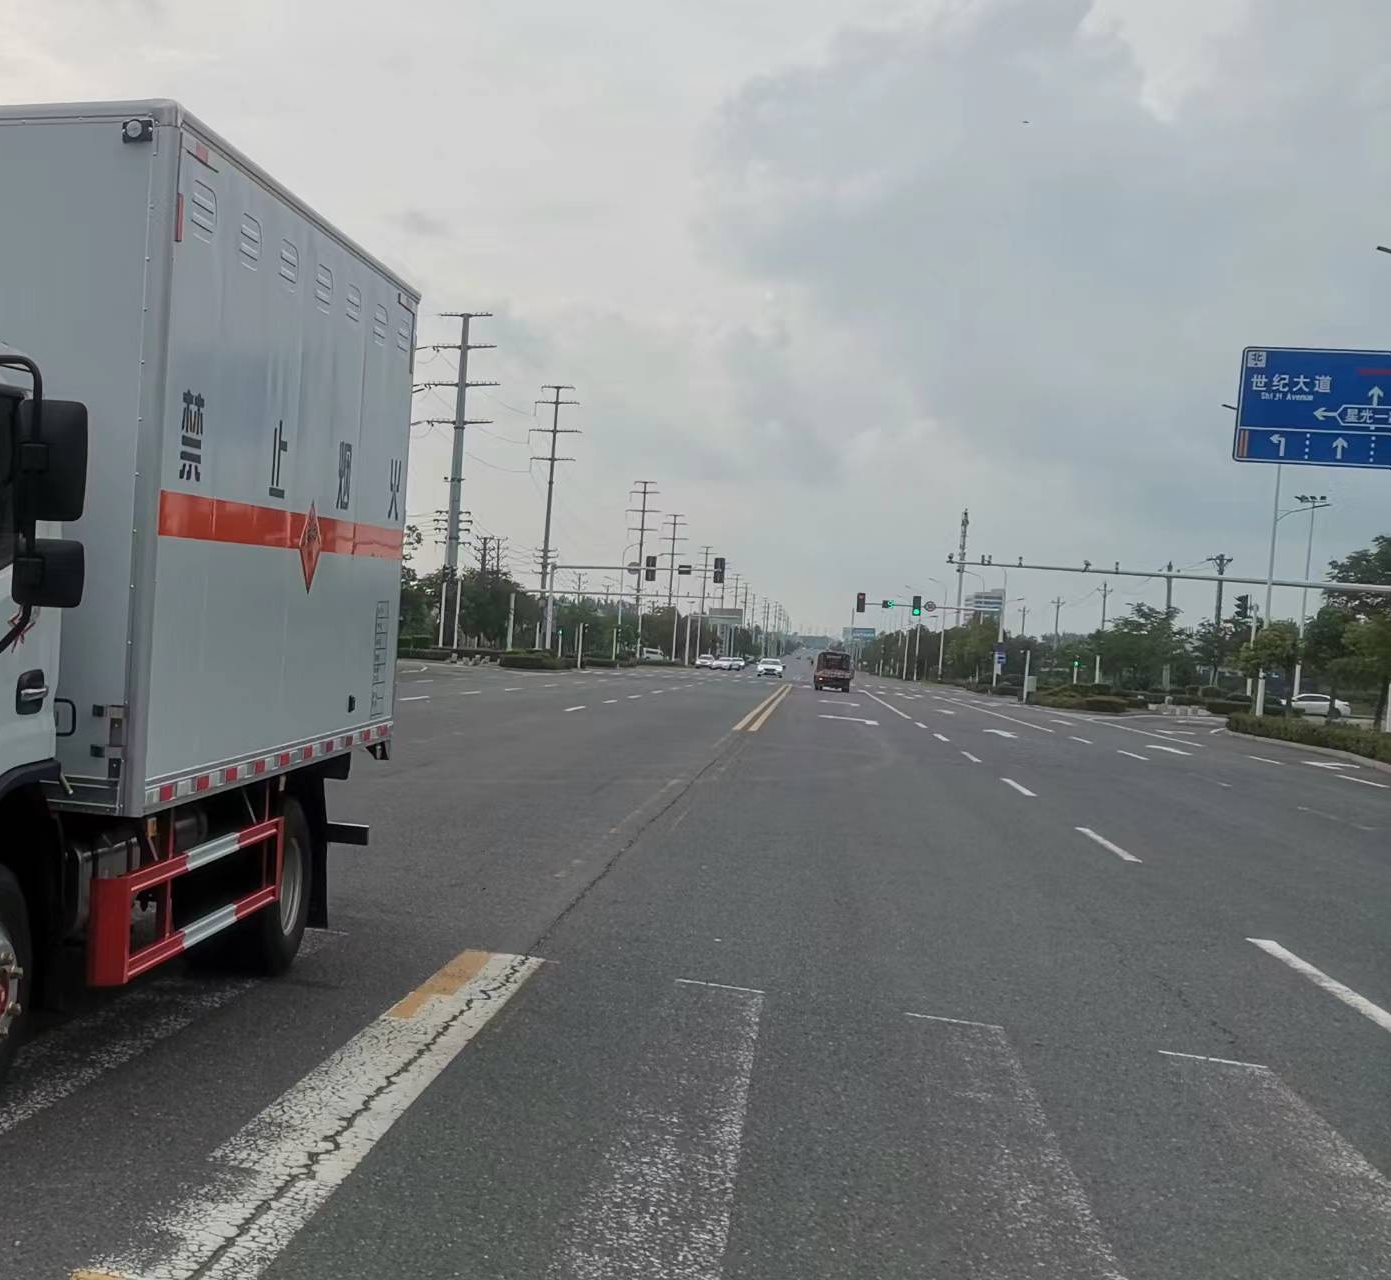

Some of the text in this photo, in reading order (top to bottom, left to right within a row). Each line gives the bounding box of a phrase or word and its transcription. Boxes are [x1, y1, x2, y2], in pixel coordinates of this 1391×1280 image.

[1250, 374, 1333, 393] 世纪大道
[1344, 408, 1391, 424] 星光一
